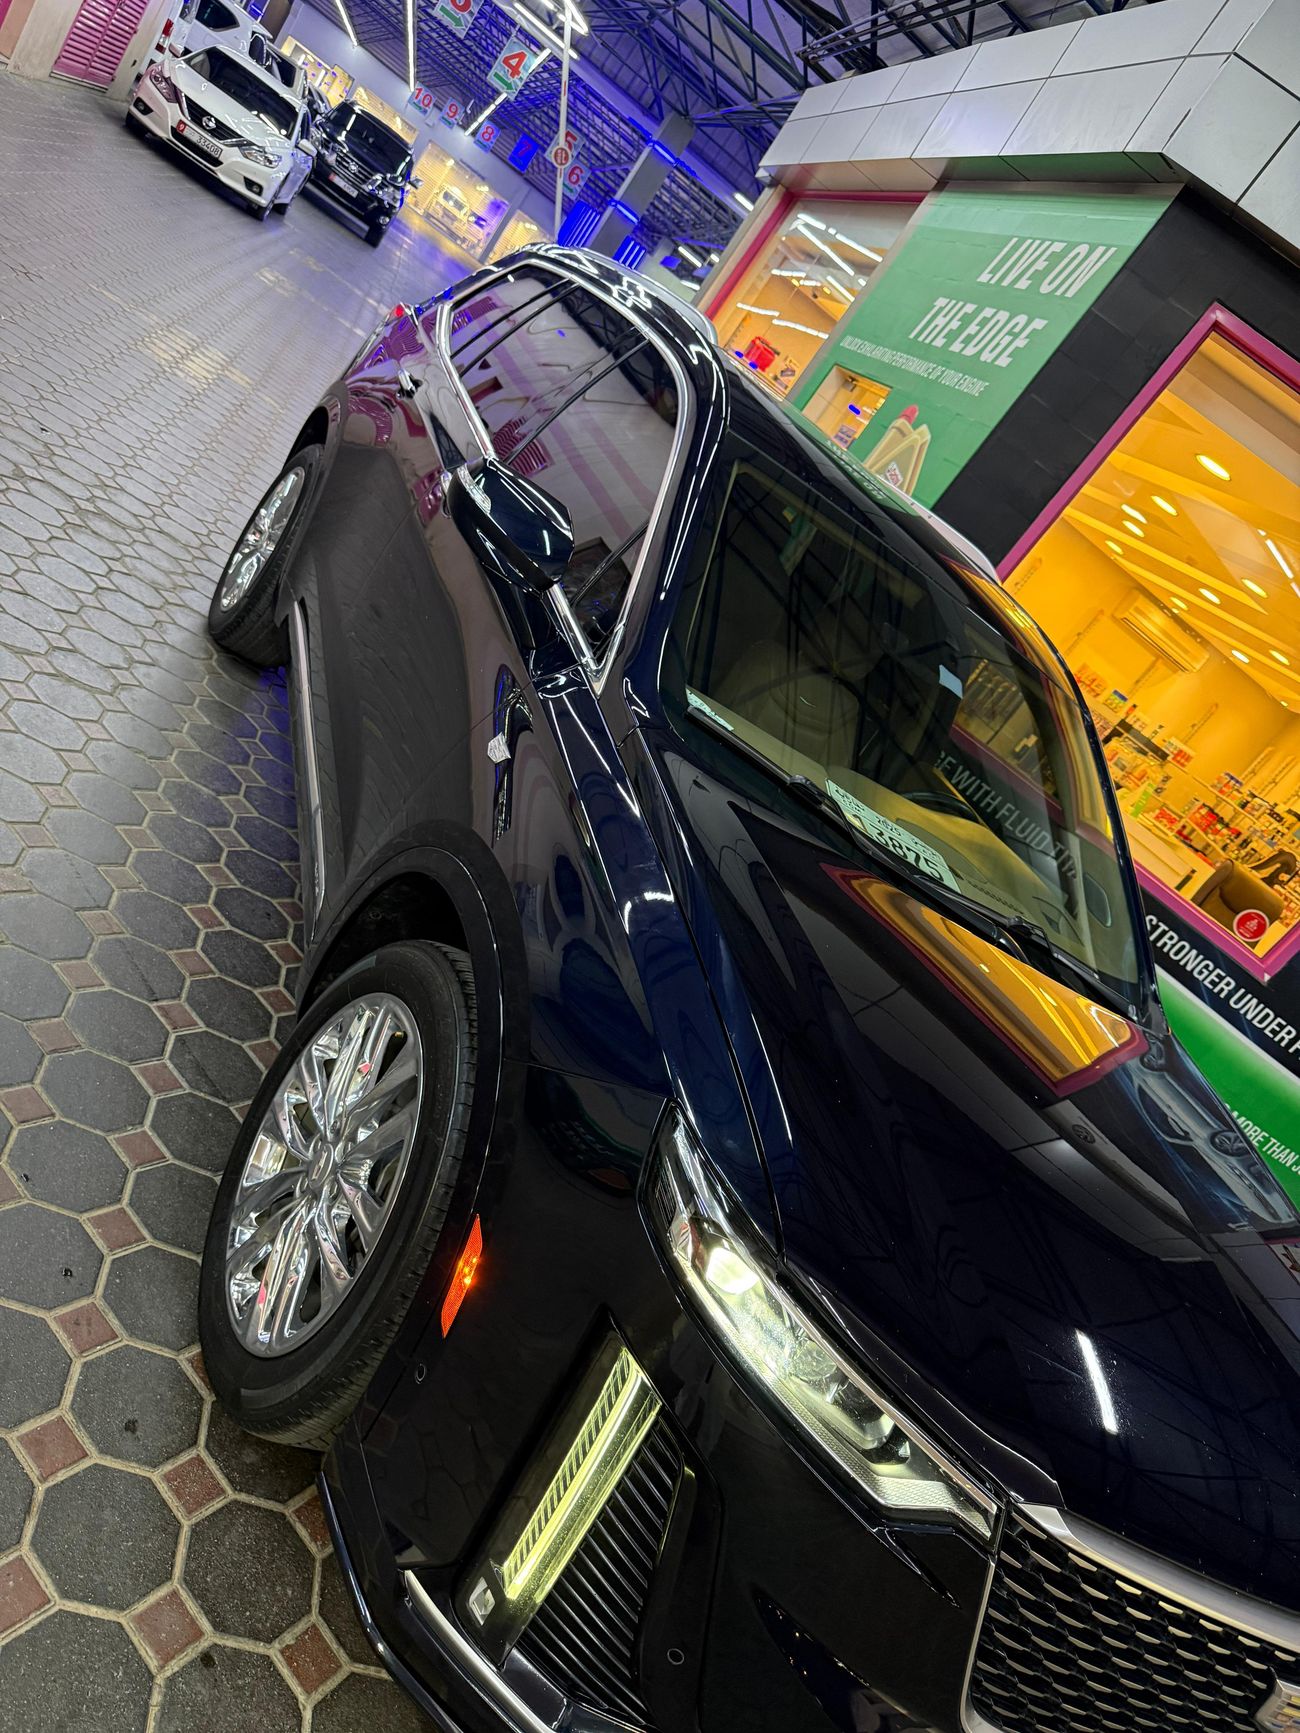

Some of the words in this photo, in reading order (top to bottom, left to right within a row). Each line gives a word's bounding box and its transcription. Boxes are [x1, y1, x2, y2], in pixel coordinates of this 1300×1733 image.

[502, 51, 528, 79] 4
[414, 87, 433, 108] 10
[446, 103, 459, 119] 9
[481, 125, 495, 142] 8
[517, 141, 532, 157] 7
[568, 165, 584, 186] 6
[977, 238, 1067, 290] LIVE
[1040, 243, 1118, 298] ON
[908, 297, 978, 348] THE
[948, 307, 1048, 368] EDGE
[954, 375, 990, 397] ENGINE
[950, 765, 1002, 813] WITH
[995, 802, 1050, 850] FLUID
[1145, 914, 1236, 999] STRONGER
[1229, 988, 1297, 1048] UNDER
[1262, 1136, 1300, 1168] THAN
